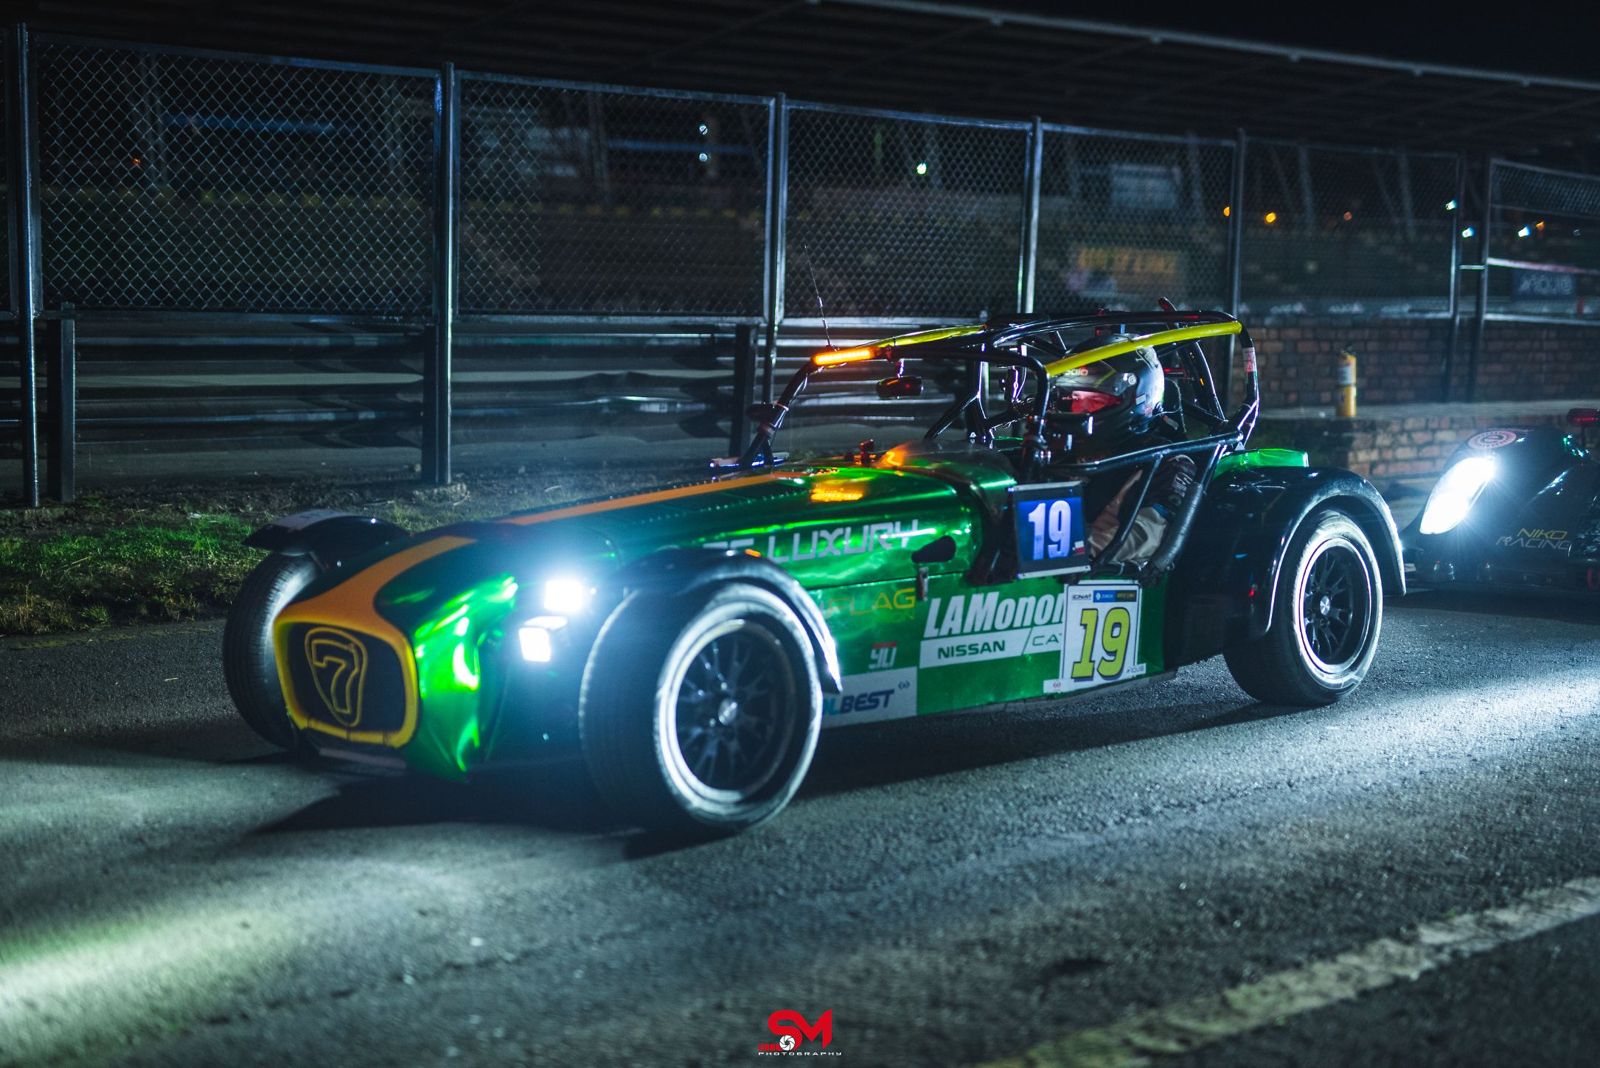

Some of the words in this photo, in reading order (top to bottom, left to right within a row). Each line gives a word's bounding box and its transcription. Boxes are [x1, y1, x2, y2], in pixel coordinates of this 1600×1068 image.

[767, 519, 919, 564] LUXURY
[1027, 500, 1071, 560] 19
[1495, 535, 1572, 554] RACING
[1517, 527, 1568, 540] NIKO
[937, 640, 1006, 660] NISSAN
[1070, 606, 1131, 682] 19
